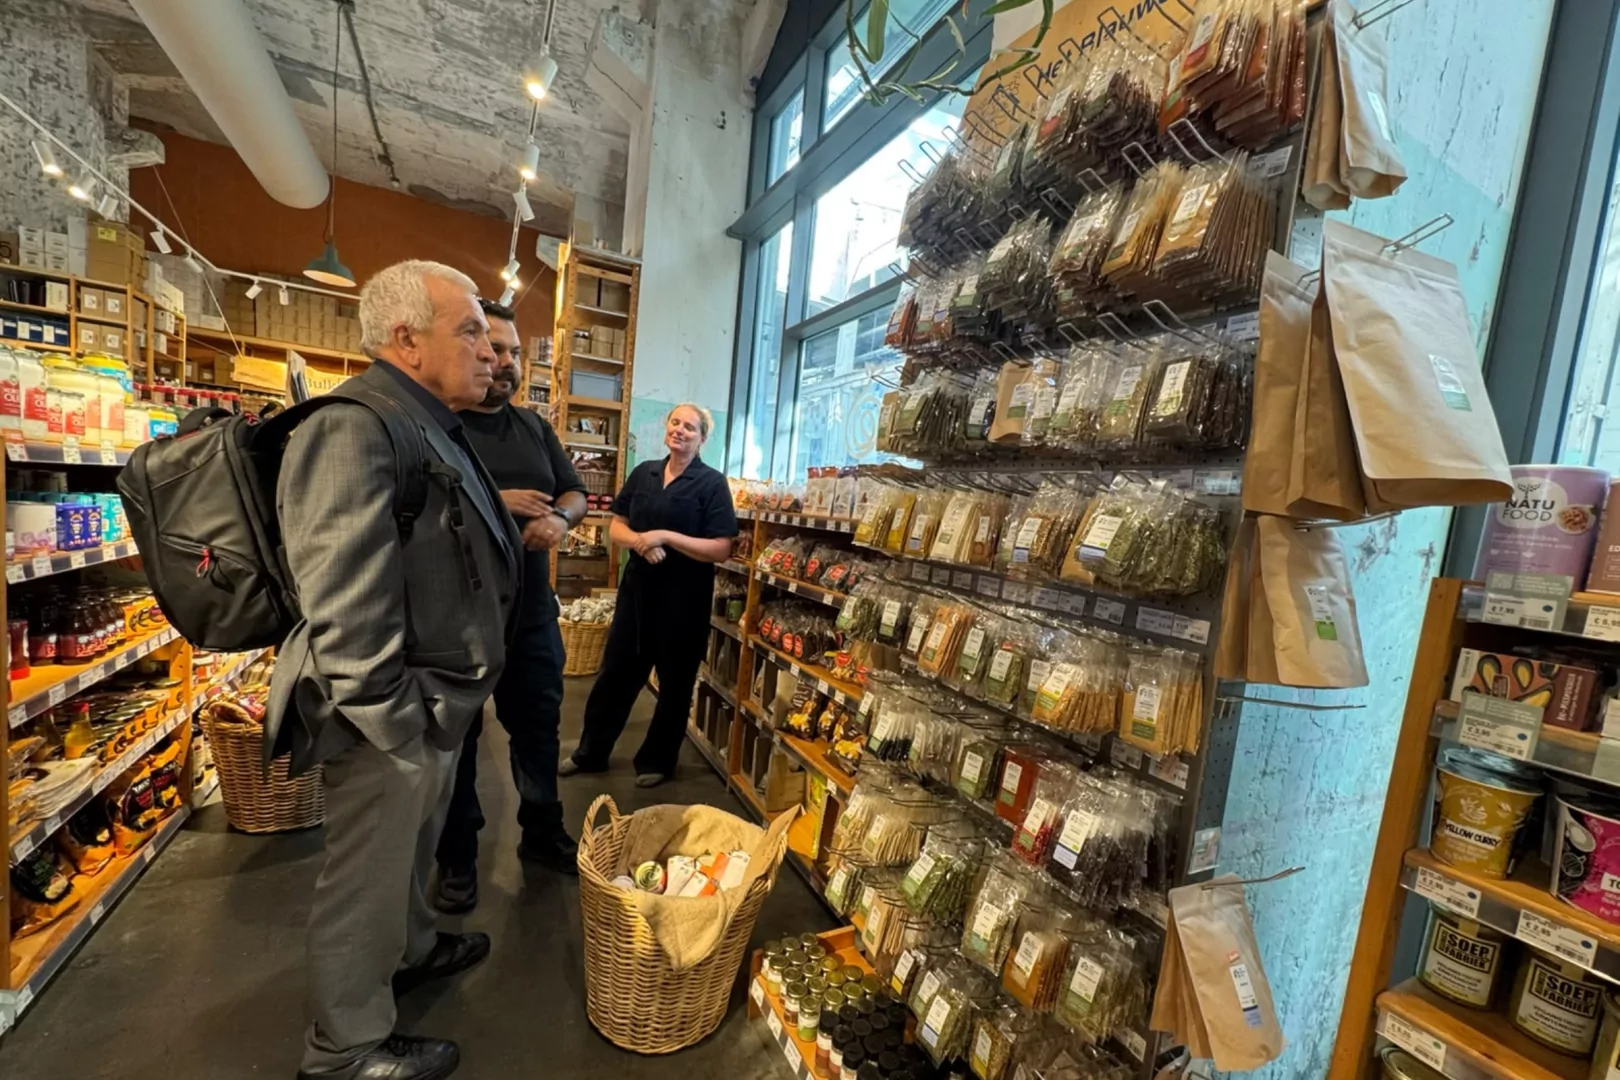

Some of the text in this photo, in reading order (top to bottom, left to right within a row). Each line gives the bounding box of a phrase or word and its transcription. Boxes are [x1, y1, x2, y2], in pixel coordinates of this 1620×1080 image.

[1502, 509, 1553, 522] FOOD
[1505, 499, 1556, 511] NATU
[1443, 822, 1500, 847] YELLOW CURRY
[1444, 946, 1486, 970] FABRIEK
[1447, 933, 1490, 959] SOEP
[1546, 972, 1595, 1001] SOEP
[1542, 988, 1592, 1016] FABRIEK
